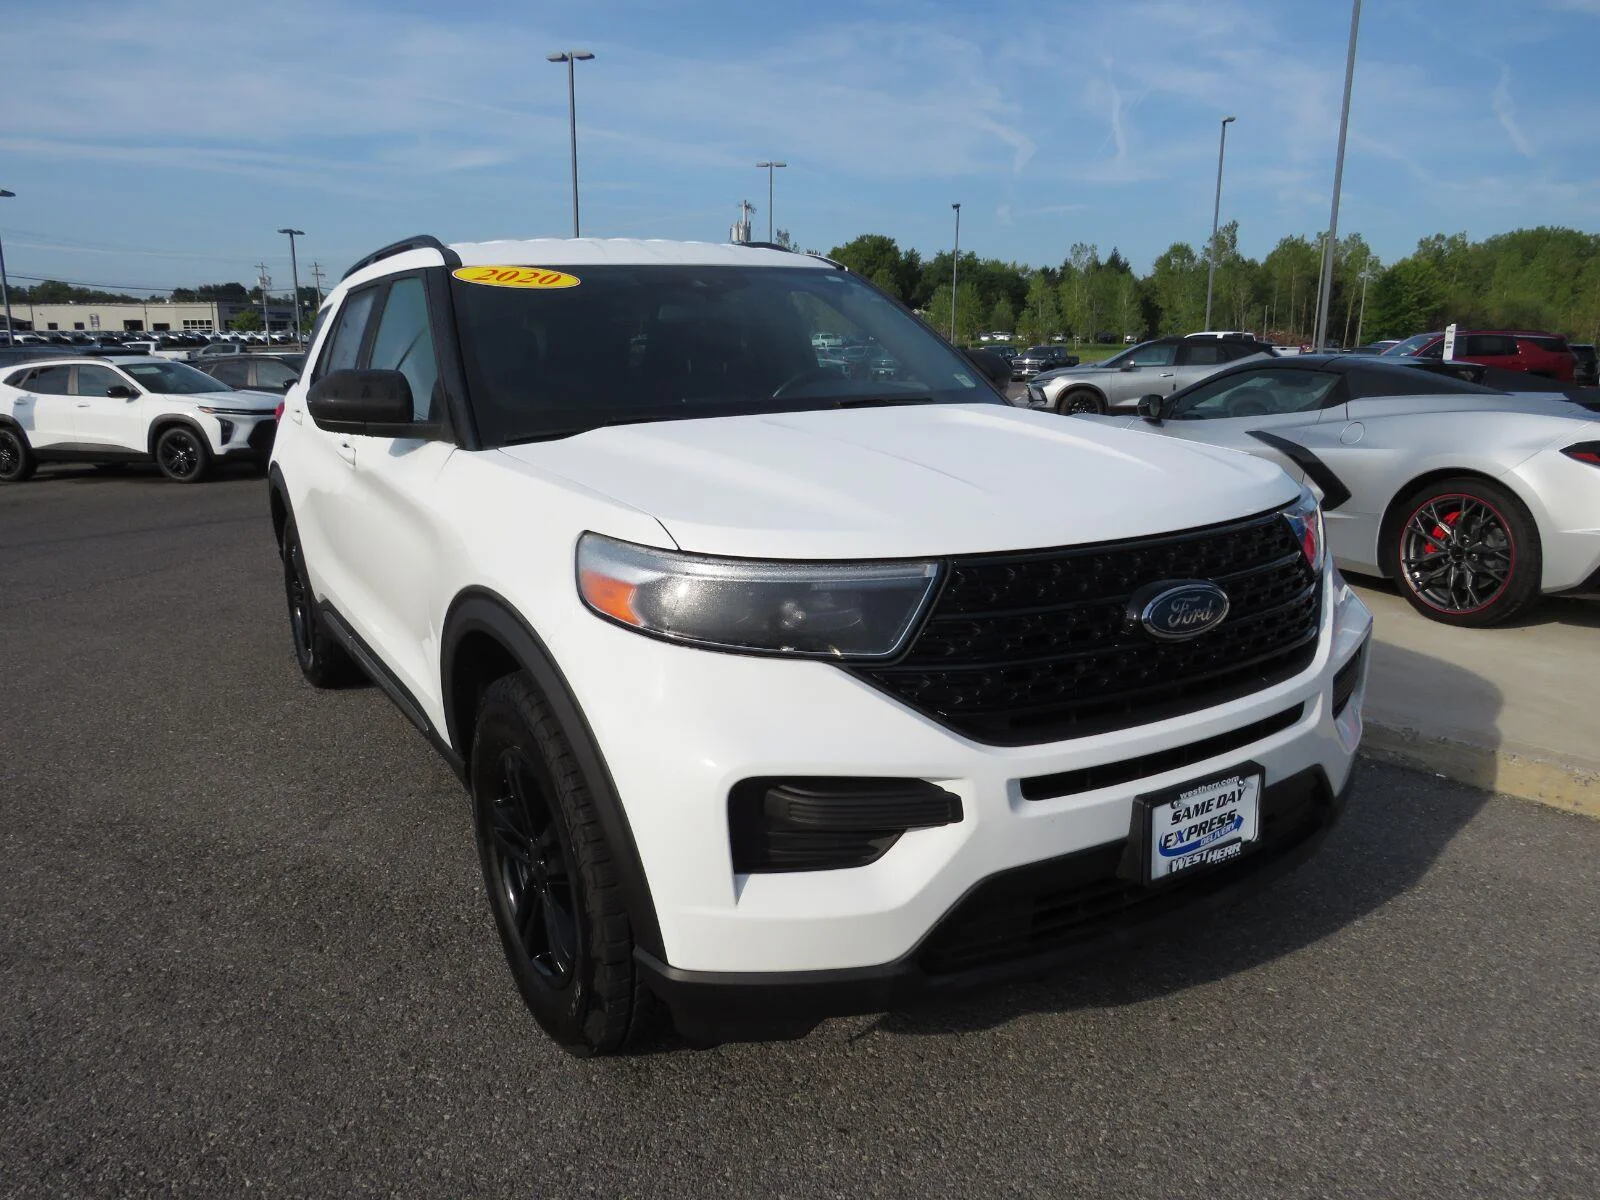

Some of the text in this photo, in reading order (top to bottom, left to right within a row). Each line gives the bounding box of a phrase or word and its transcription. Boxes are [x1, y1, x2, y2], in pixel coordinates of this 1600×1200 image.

[473, 269, 561, 285] 2020
[1168, 596, 1213, 627] Ford
[1171, 786, 1247, 826] SAME DAY
[1163, 809, 1237, 849] EXPRESS
